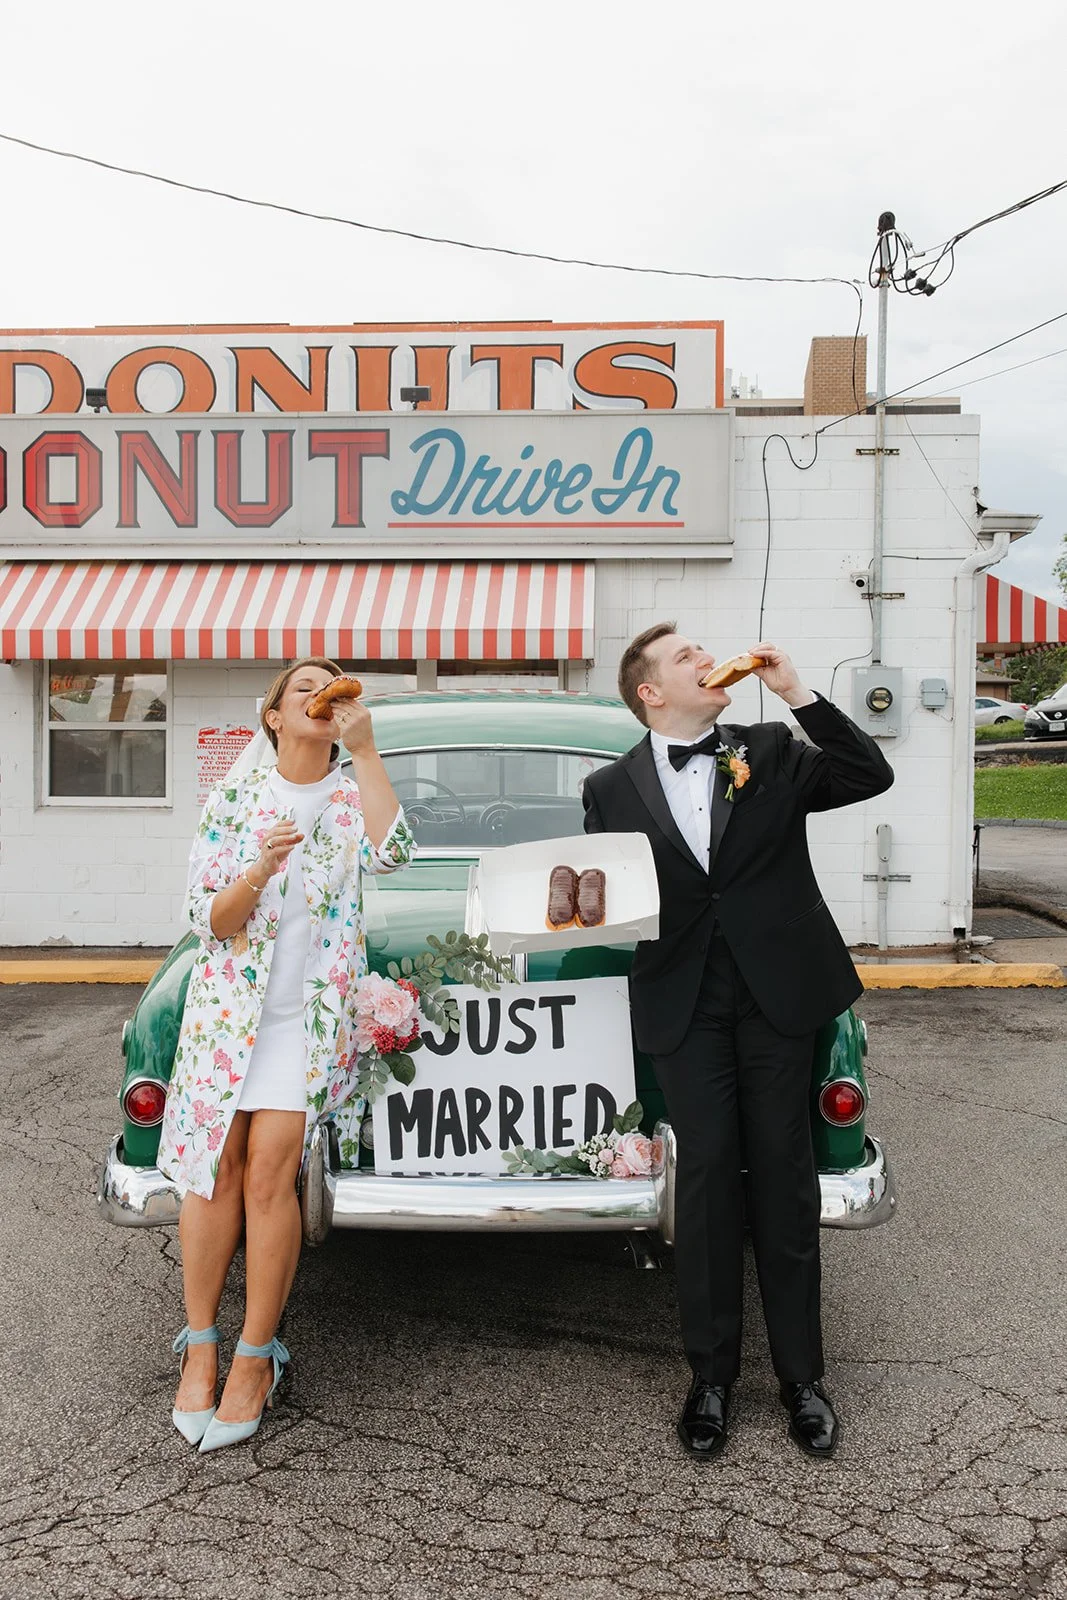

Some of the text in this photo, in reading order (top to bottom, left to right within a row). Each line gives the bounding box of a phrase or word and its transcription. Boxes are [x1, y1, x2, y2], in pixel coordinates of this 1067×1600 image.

[0, 341, 678, 413] DONUTS
[0, 427, 681, 529] ONUT Drive In
[421, 995, 576, 1056] JUST
[387, 1083, 617, 1161] MARRIED
